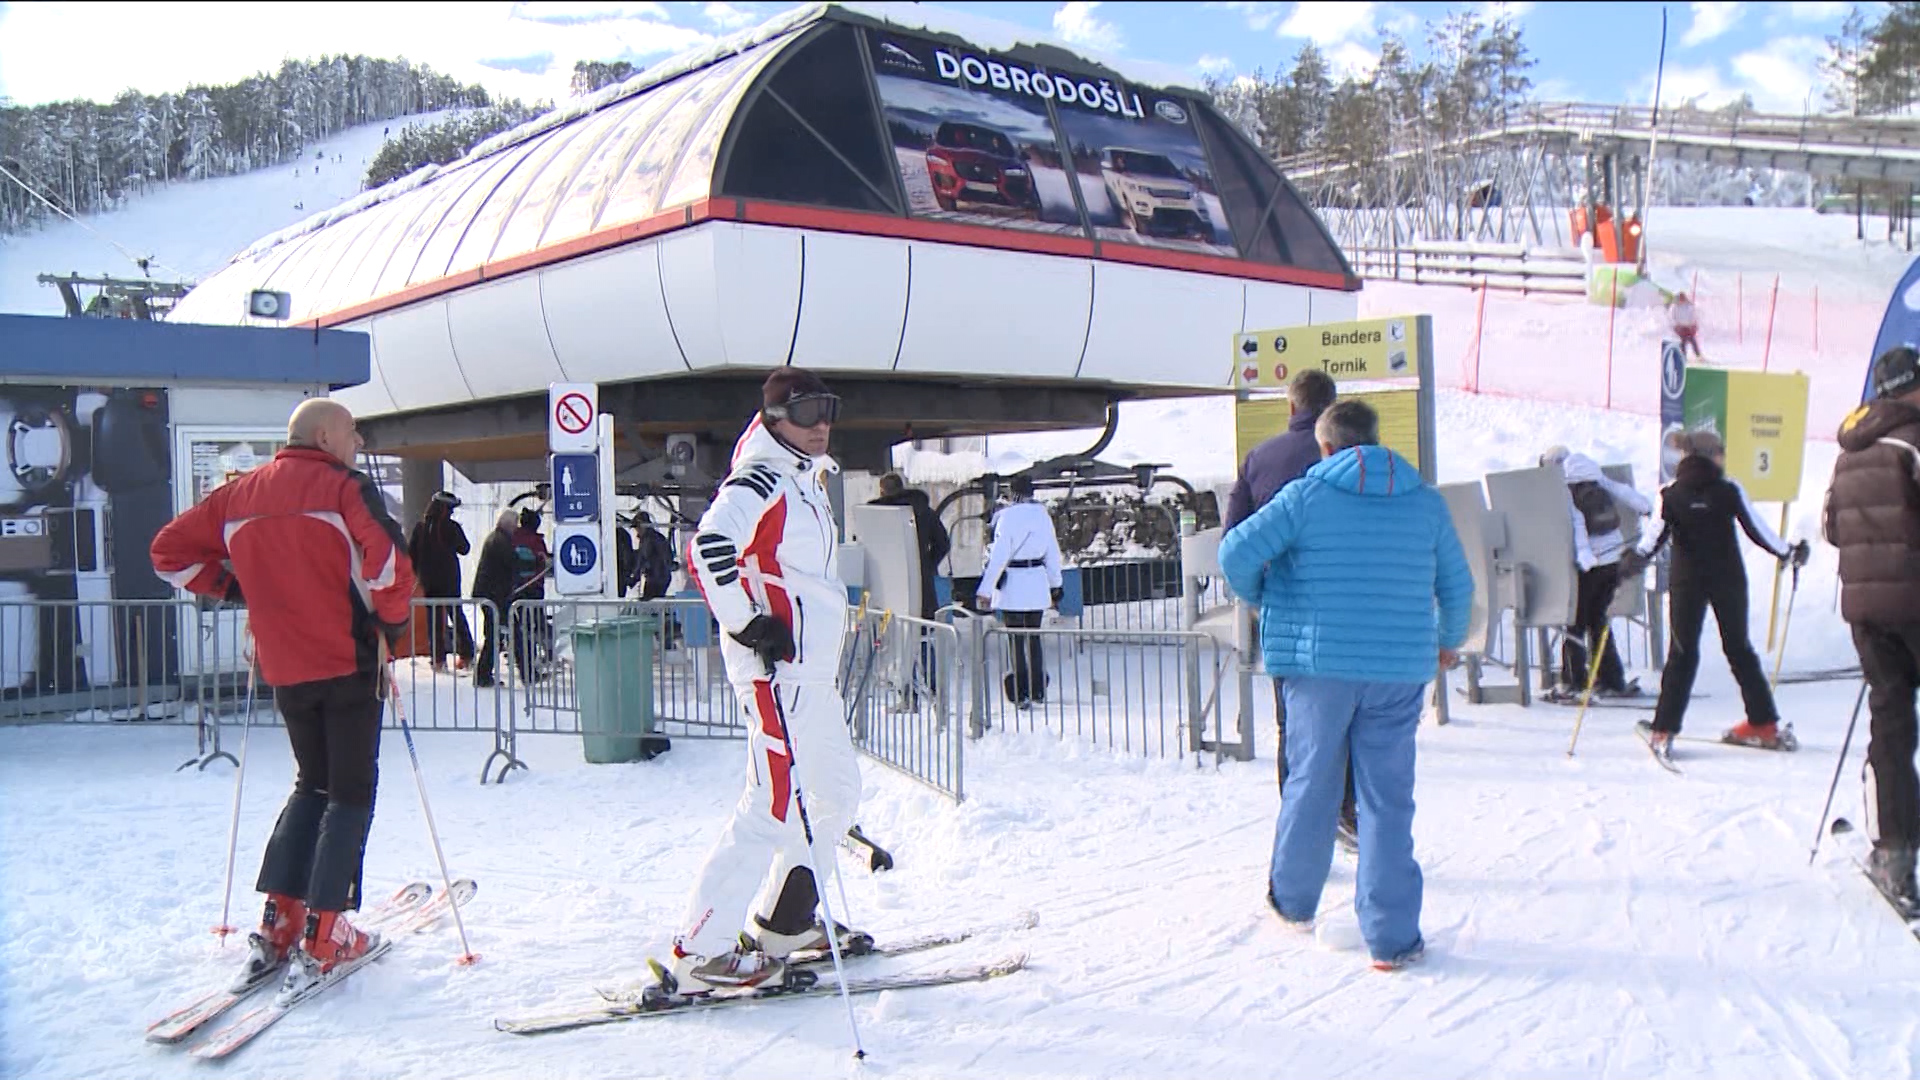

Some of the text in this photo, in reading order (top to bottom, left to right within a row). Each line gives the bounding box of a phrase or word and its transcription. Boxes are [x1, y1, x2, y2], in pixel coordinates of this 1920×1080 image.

[934, 49, 1145, 118] DOBRODOŠLI
[1277, 330, 1382, 351] 2 Bandera
[1321, 358, 1367, 374] Tornik
[1759, 452, 1769, 472] 3
